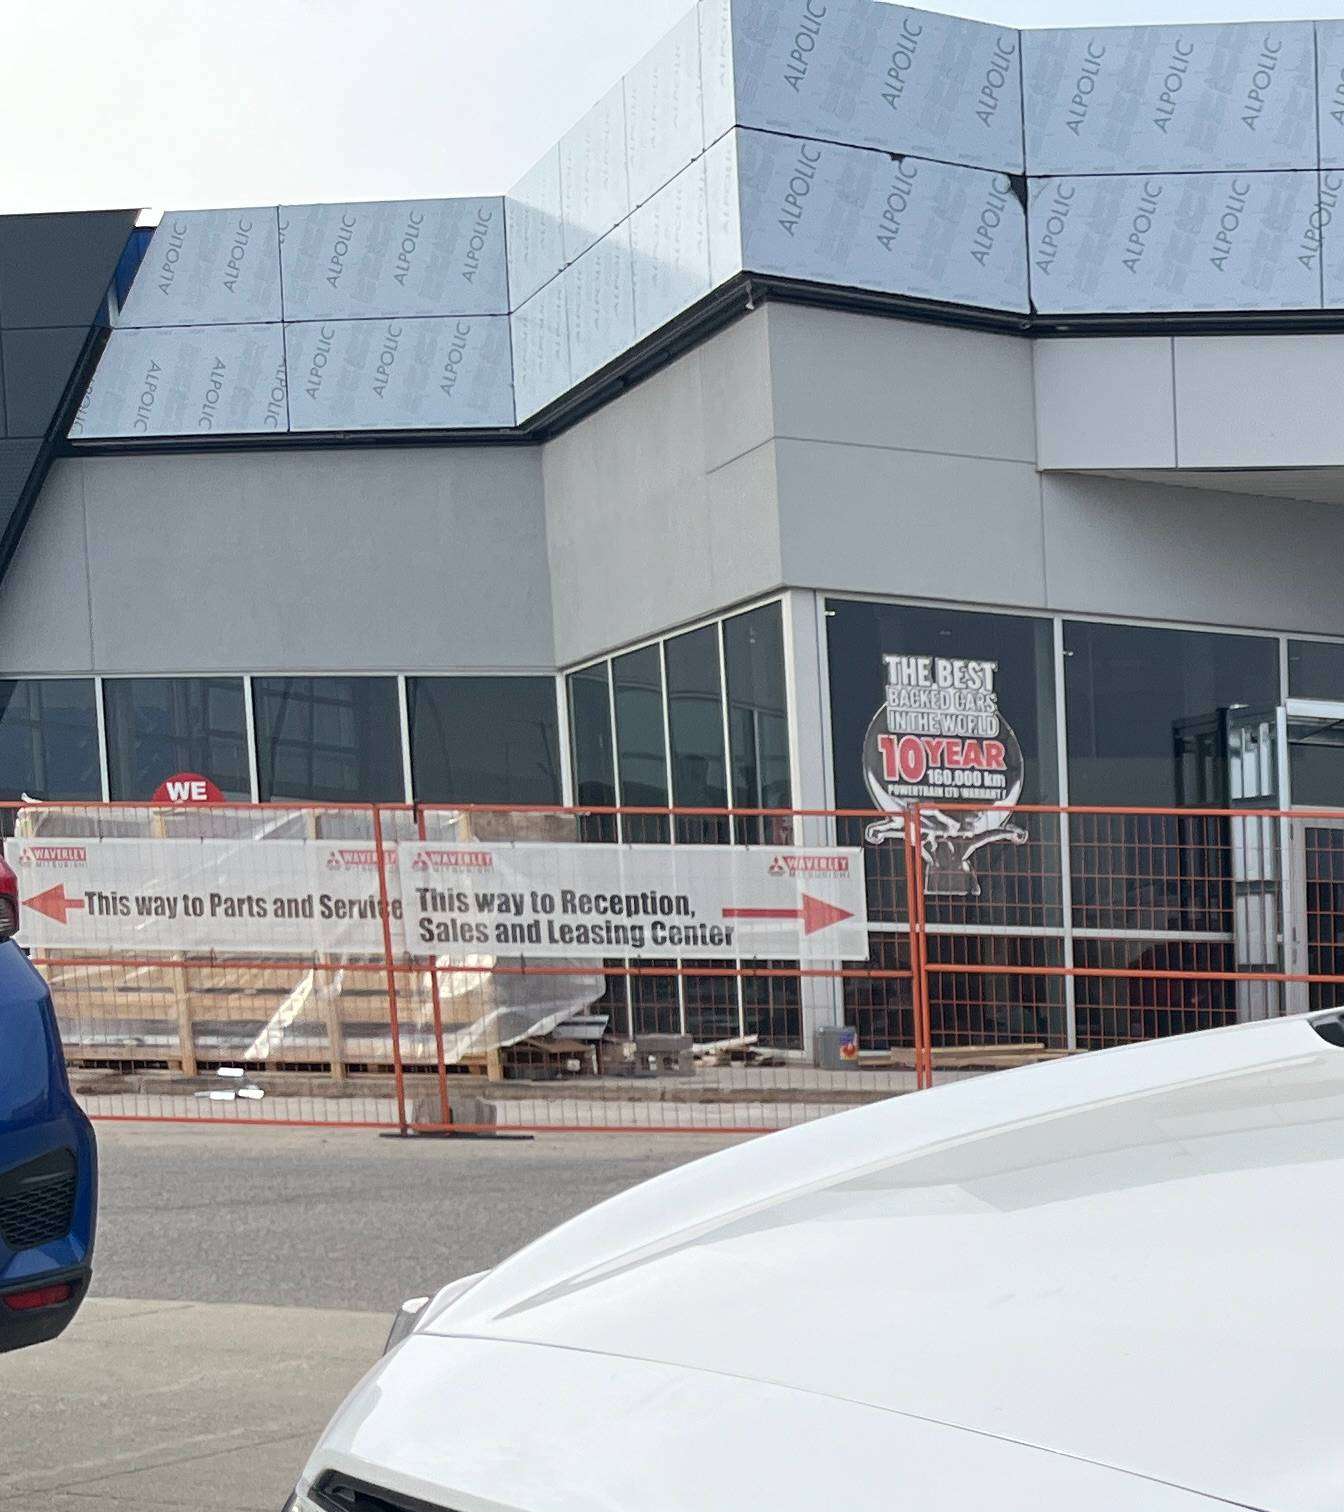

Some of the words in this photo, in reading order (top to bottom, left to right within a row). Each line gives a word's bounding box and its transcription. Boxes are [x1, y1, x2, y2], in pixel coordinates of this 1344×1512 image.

[783, 0, 827, 93] ALPOLIC
[880, 18, 923, 110] ALPOLIC
[975, 38, 1016, 127] ALPOLIC
[1241, 33, 1282, 131] ALPOLIC
[1066, 40, 1106, 136] ALPOLIC
[1152, 38, 1194, 134] ALPOLIC
[778, 143, 822, 237] ALPOLIC
[876, 160, 918, 252] ALPOLIC
[970, 173, 1010, 267] ALPOLIC
[1122, 180, 1163, 274] ALPOLIC
[1209, 178, 1250, 272] ALPOLIC
[158, 222, 188, 295] ALPOLIC
[224, 219, 253, 293] ALPOLIC
[326, 214, 357, 288] ALPOLIC
[393, 211, 424, 286] ALPOLIC
[462, 207, 493, 284] ALPOLIC
[1035, 182, 1075, 276] ALPOLIC
[134, 359, 162, 432] ALPOLIC
[198, 356, 226, 430] ALPOLIC
[306, 326, 335, 400] ALPOLIC
[372, 324, 403, 399] ALPOLIC
[439, 320, 471, 397] ALPOLIC
[885, 655, 933, 688] THE
[935, 658, 998, 692] BEST
[887, 687, 950, 711] BACKED
[952, 690, 998, 713] CARS
[878, 735, 926, 783] 10
[923, 737, 1007, 770] YEAR
[888, 711, 909, 732] IN
[909, 713, 938, 735] THE
[939, 714, 999, 737] WORLD
[166, 782, 207, 801] WE
[984, 772, 1005, 787] km
[85, 891, 129, 917] This
[136, 894, 178, 920] way
[182, 892, 204, 917] to
[210, 893, 268, 918] Parts
[273, 894, 314, 918] and
[416, 888, 470, 916] This
[475, 893, 524, 922] way
[531, 889, 554, 915] to
[561, 889, 697, 921] Reception,
[420, 917, 490, 944] Sales
[495, 919, 541, 945] and
[549, 920, 645, 949] Leasing
[651, 920, 736, 947] Center
